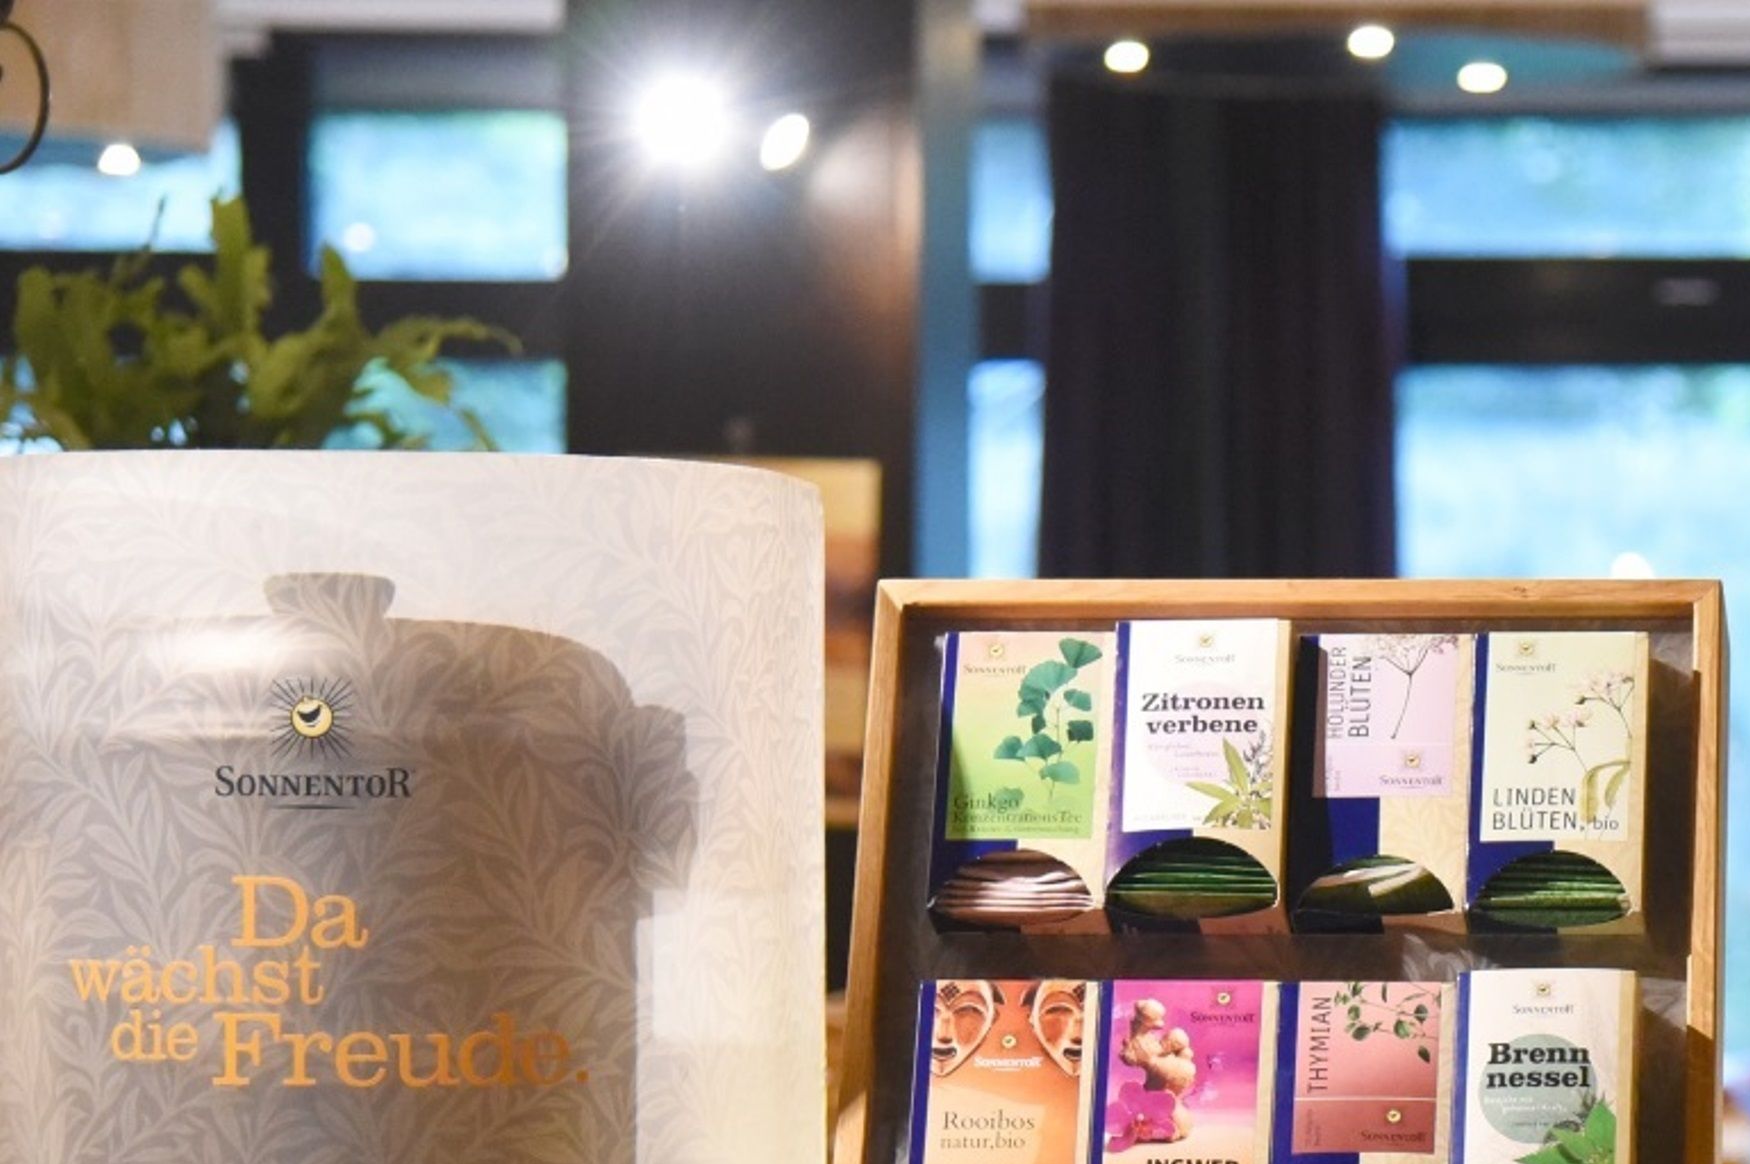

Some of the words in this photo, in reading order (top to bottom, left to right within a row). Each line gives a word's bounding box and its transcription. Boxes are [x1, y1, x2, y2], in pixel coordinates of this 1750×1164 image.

[1142, 692, 1265, 712] Zitronen
[1327, 645, 1347, 740] HOLUNDER
[1348, 654, 1373, 739] BLÜTEN
[1147, 715, 1259, 734] verbene
[214, 765, 412, 799] SONNENTOR
[1492, 787, 1577, 807] LINDEN
[1592, 816, 1620, 831] bio
[230, 874, 370, 950] Da
[69, 944, 326, 1007] wächst
[111, 1009, 199, 1062] die
[212, 1011, 590, 1089] Freude.
[1307, 996, 1332, 1094] THYMIAN
[1487, 1042, 1591, 1066] Brenn
[1485, 1066, 1592, 1089] nessel
[941, 1109, 1036, 1131] Rooibos
